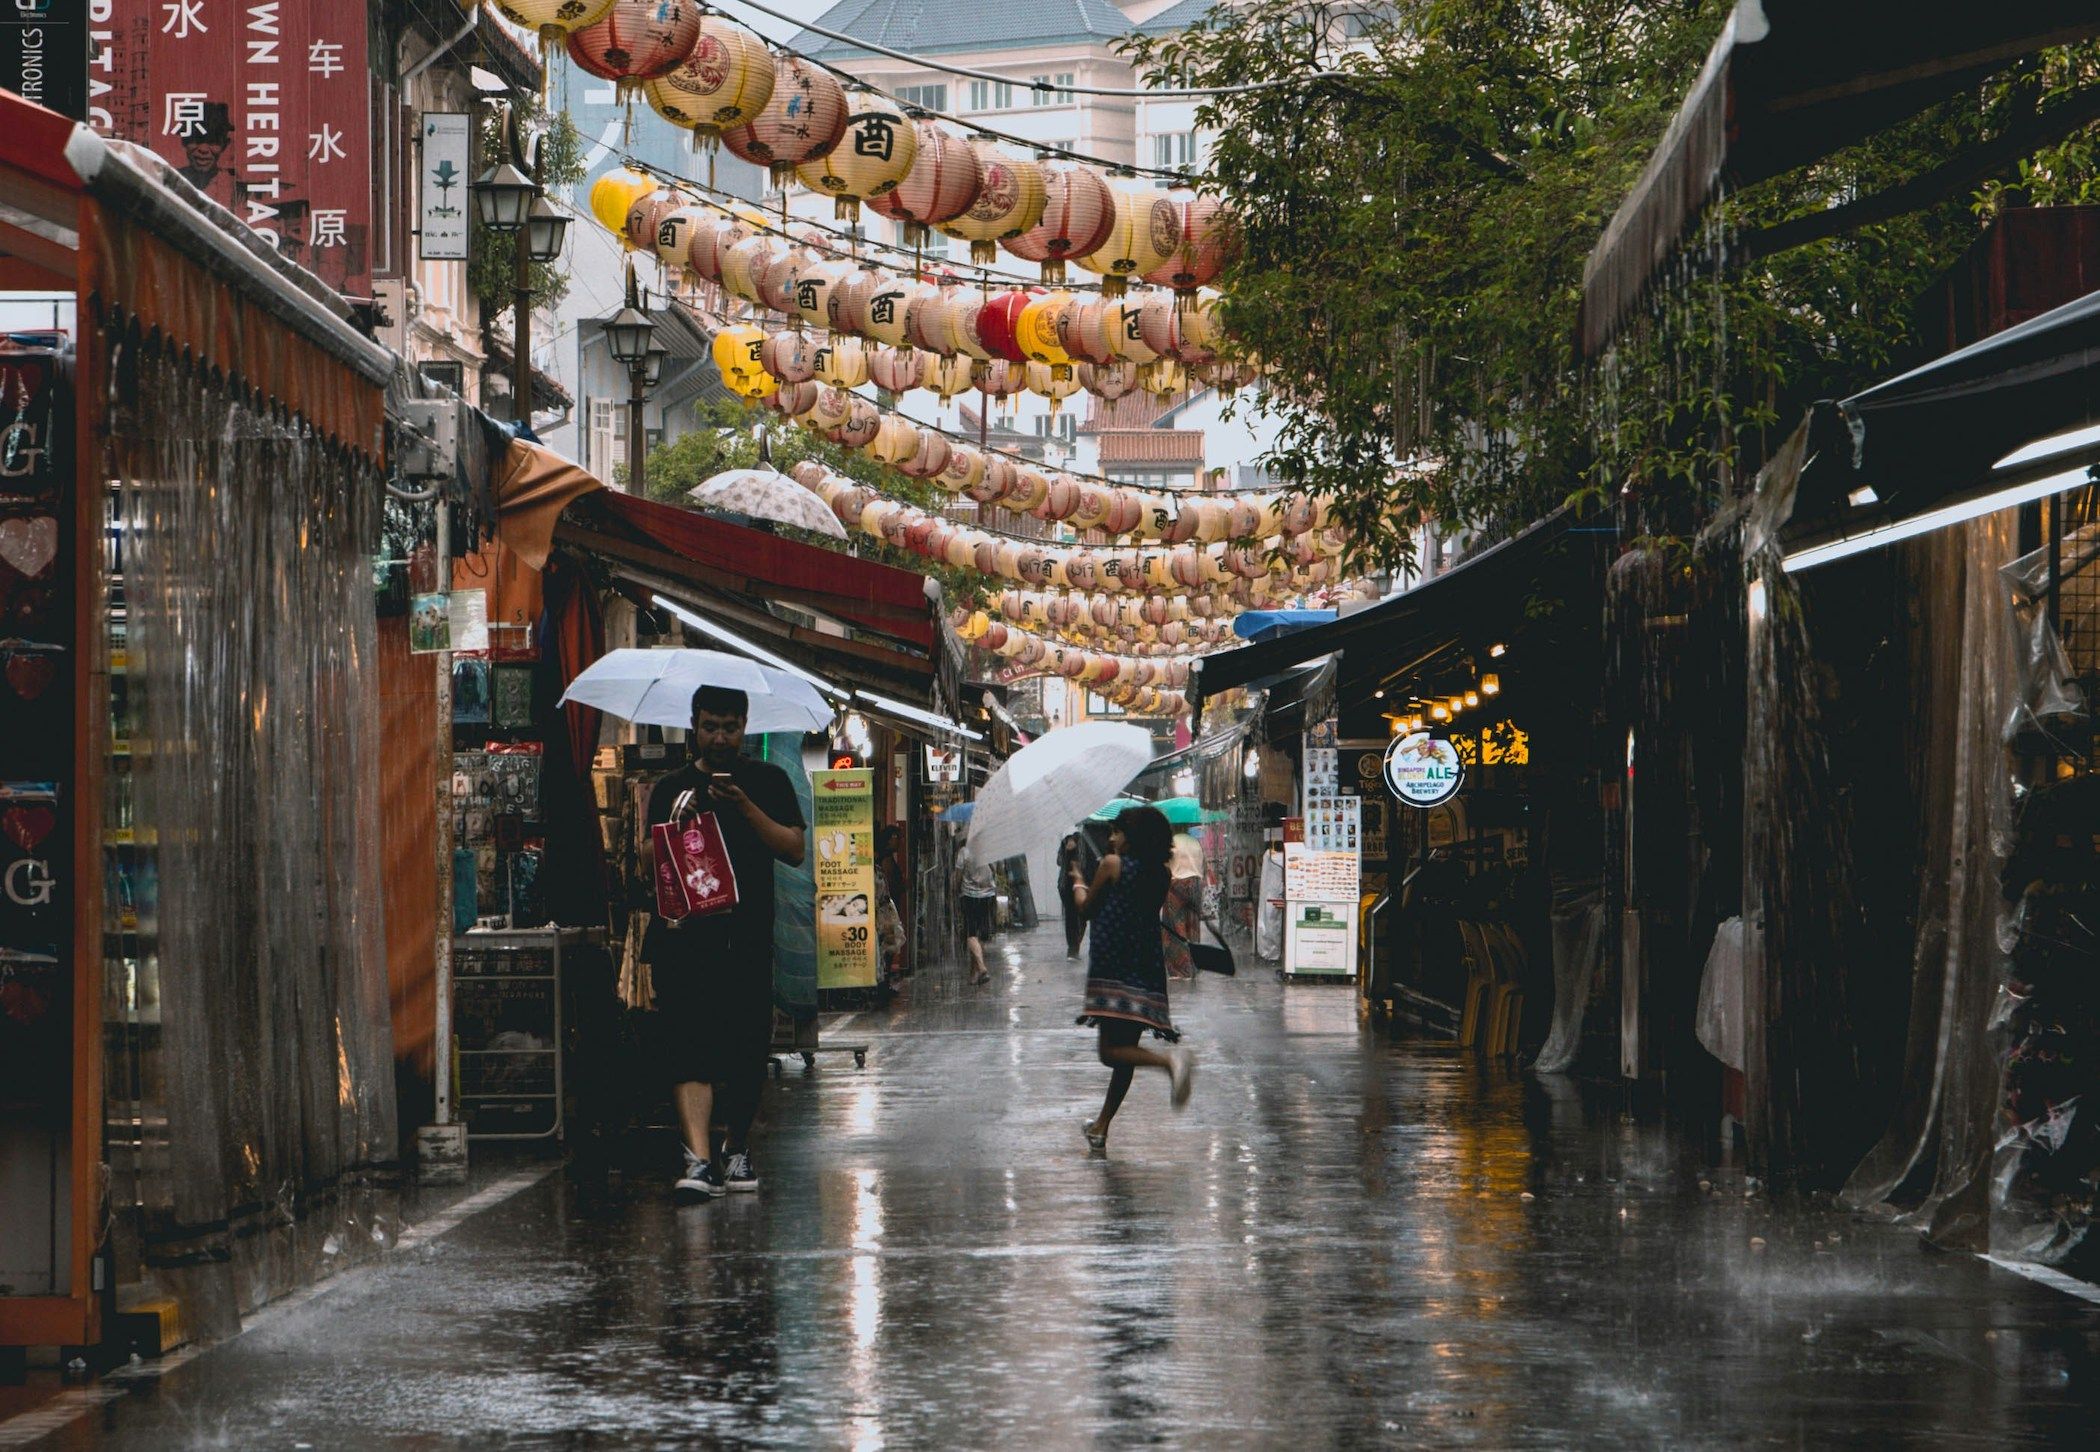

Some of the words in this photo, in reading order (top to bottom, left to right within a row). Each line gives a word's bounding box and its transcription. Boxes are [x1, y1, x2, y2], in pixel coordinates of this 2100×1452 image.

[308, 38, 347, 248] 车水原
[1427, 767, 1452, 779] ALE
[4, 858, 56, 905] G
